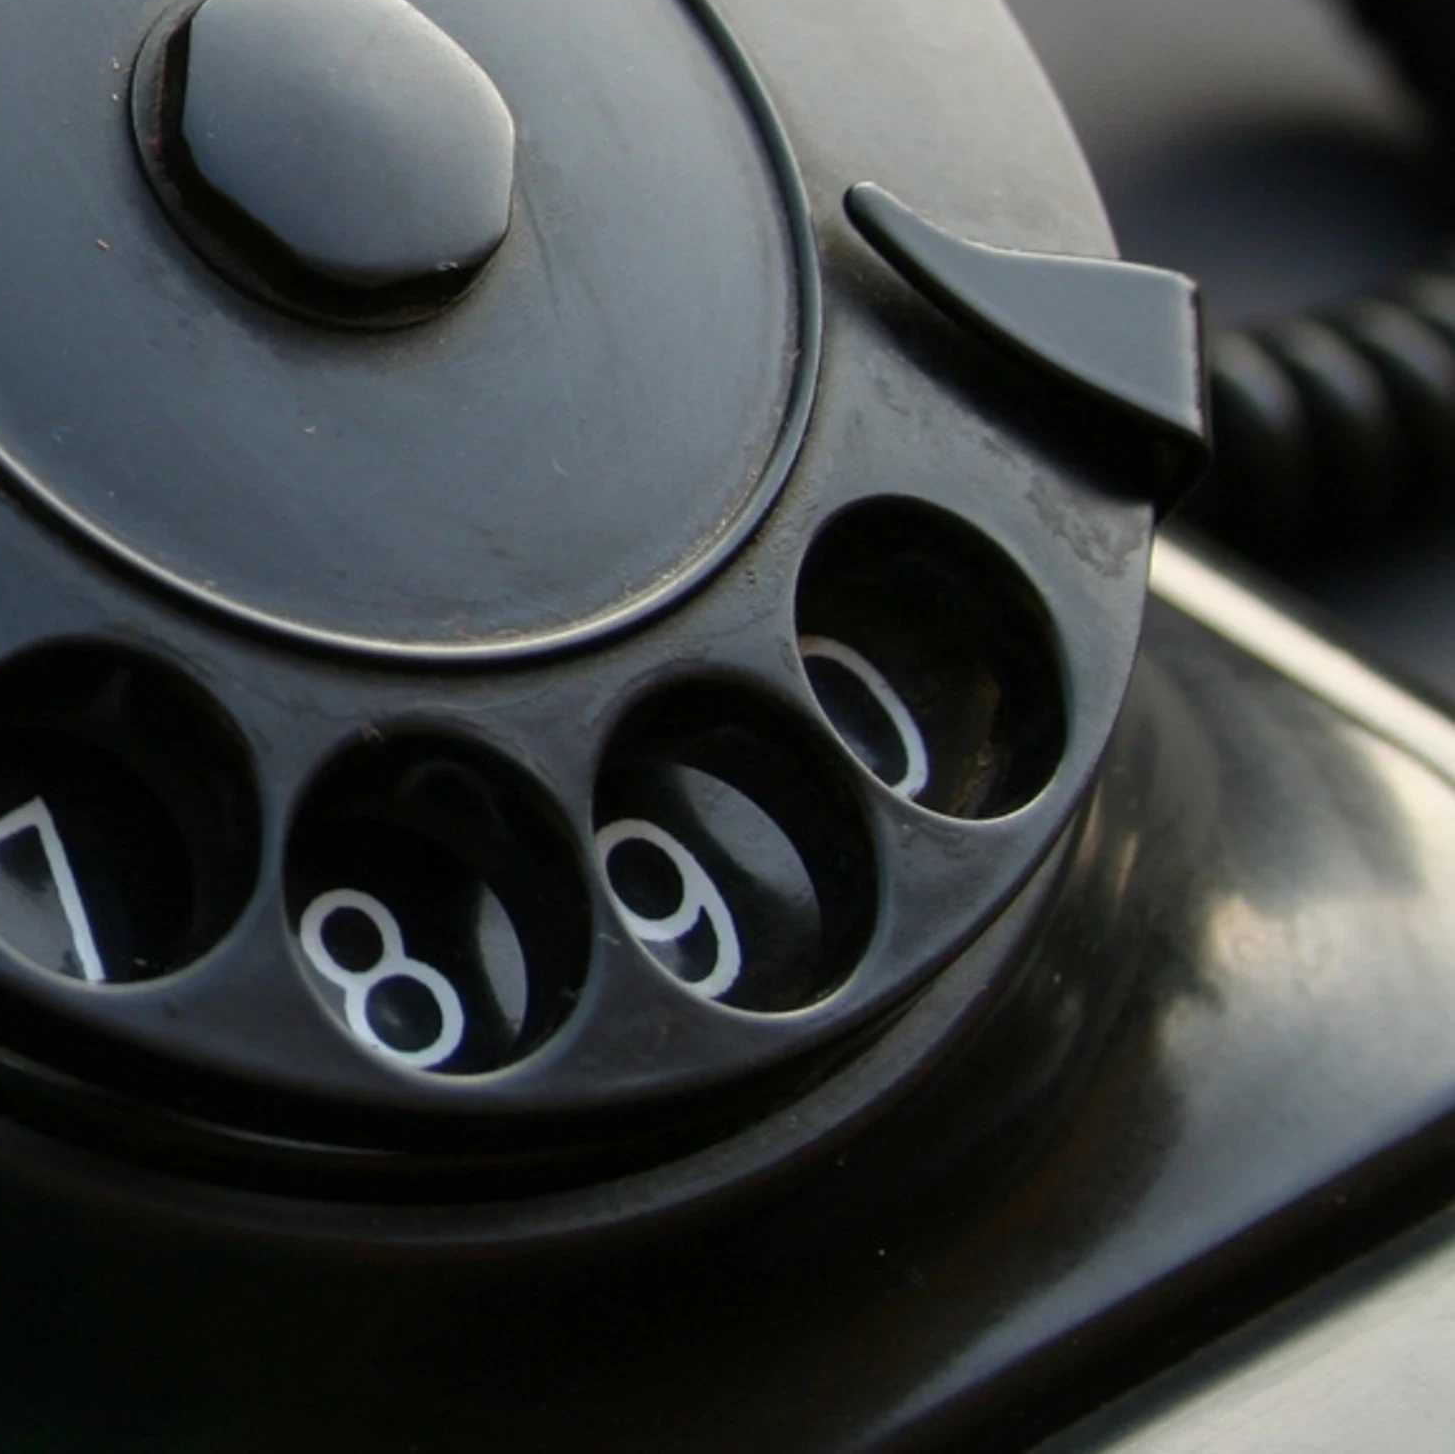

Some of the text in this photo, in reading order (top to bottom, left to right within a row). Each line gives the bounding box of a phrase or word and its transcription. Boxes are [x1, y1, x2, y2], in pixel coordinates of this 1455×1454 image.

[799, 634, 928, 800] 0
[300, 888, 464, 1069] 8
[595, 818, 741, 999] 9
